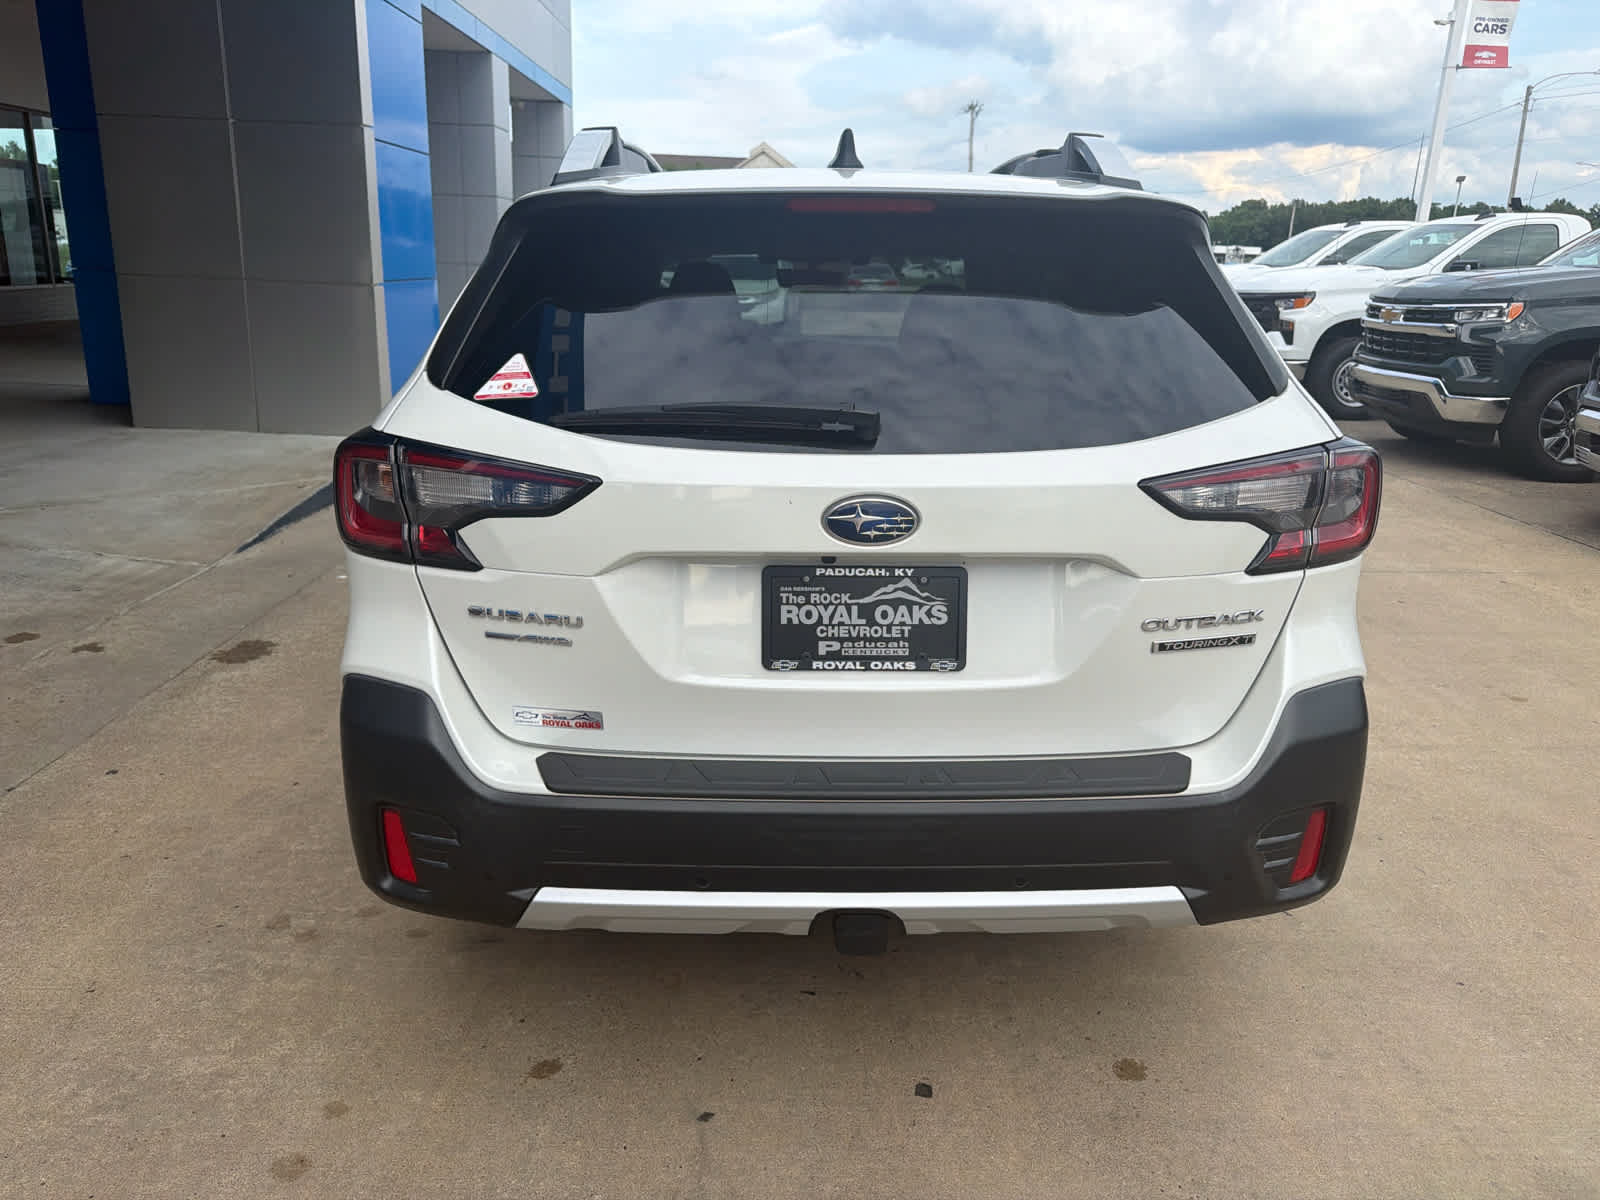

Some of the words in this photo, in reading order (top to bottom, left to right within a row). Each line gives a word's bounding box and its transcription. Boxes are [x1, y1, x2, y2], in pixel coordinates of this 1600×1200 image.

[1474, 23, 1507, 34] CARS
[815, 568, 890, 577] PADUCAH,
[894, 568, 915, 577] KY
[779, 592, 806, 604] The
[810, 592, 851, 604] ROCK
[467, 605, 584, 628] SUBARU
[780, 604, 867, 625] ROYAL
[874, 604, 949, 625] OAKS
[1141, 608, 1264, 632] OUTBACK
[816, 625, 912, 638] CHEVROLET
[818, 640, 909, 656] Paducah
[1164, 638, 1227, 650] TOURING
[843, 648, 909, 656] KENTUCKY
[811, 660, 865, 670] ROYAL
[870, 660, 917, 670] OAKS
[541, 719, 573, 728] ROYAL
[574, 720, 601, 729] OAKS
